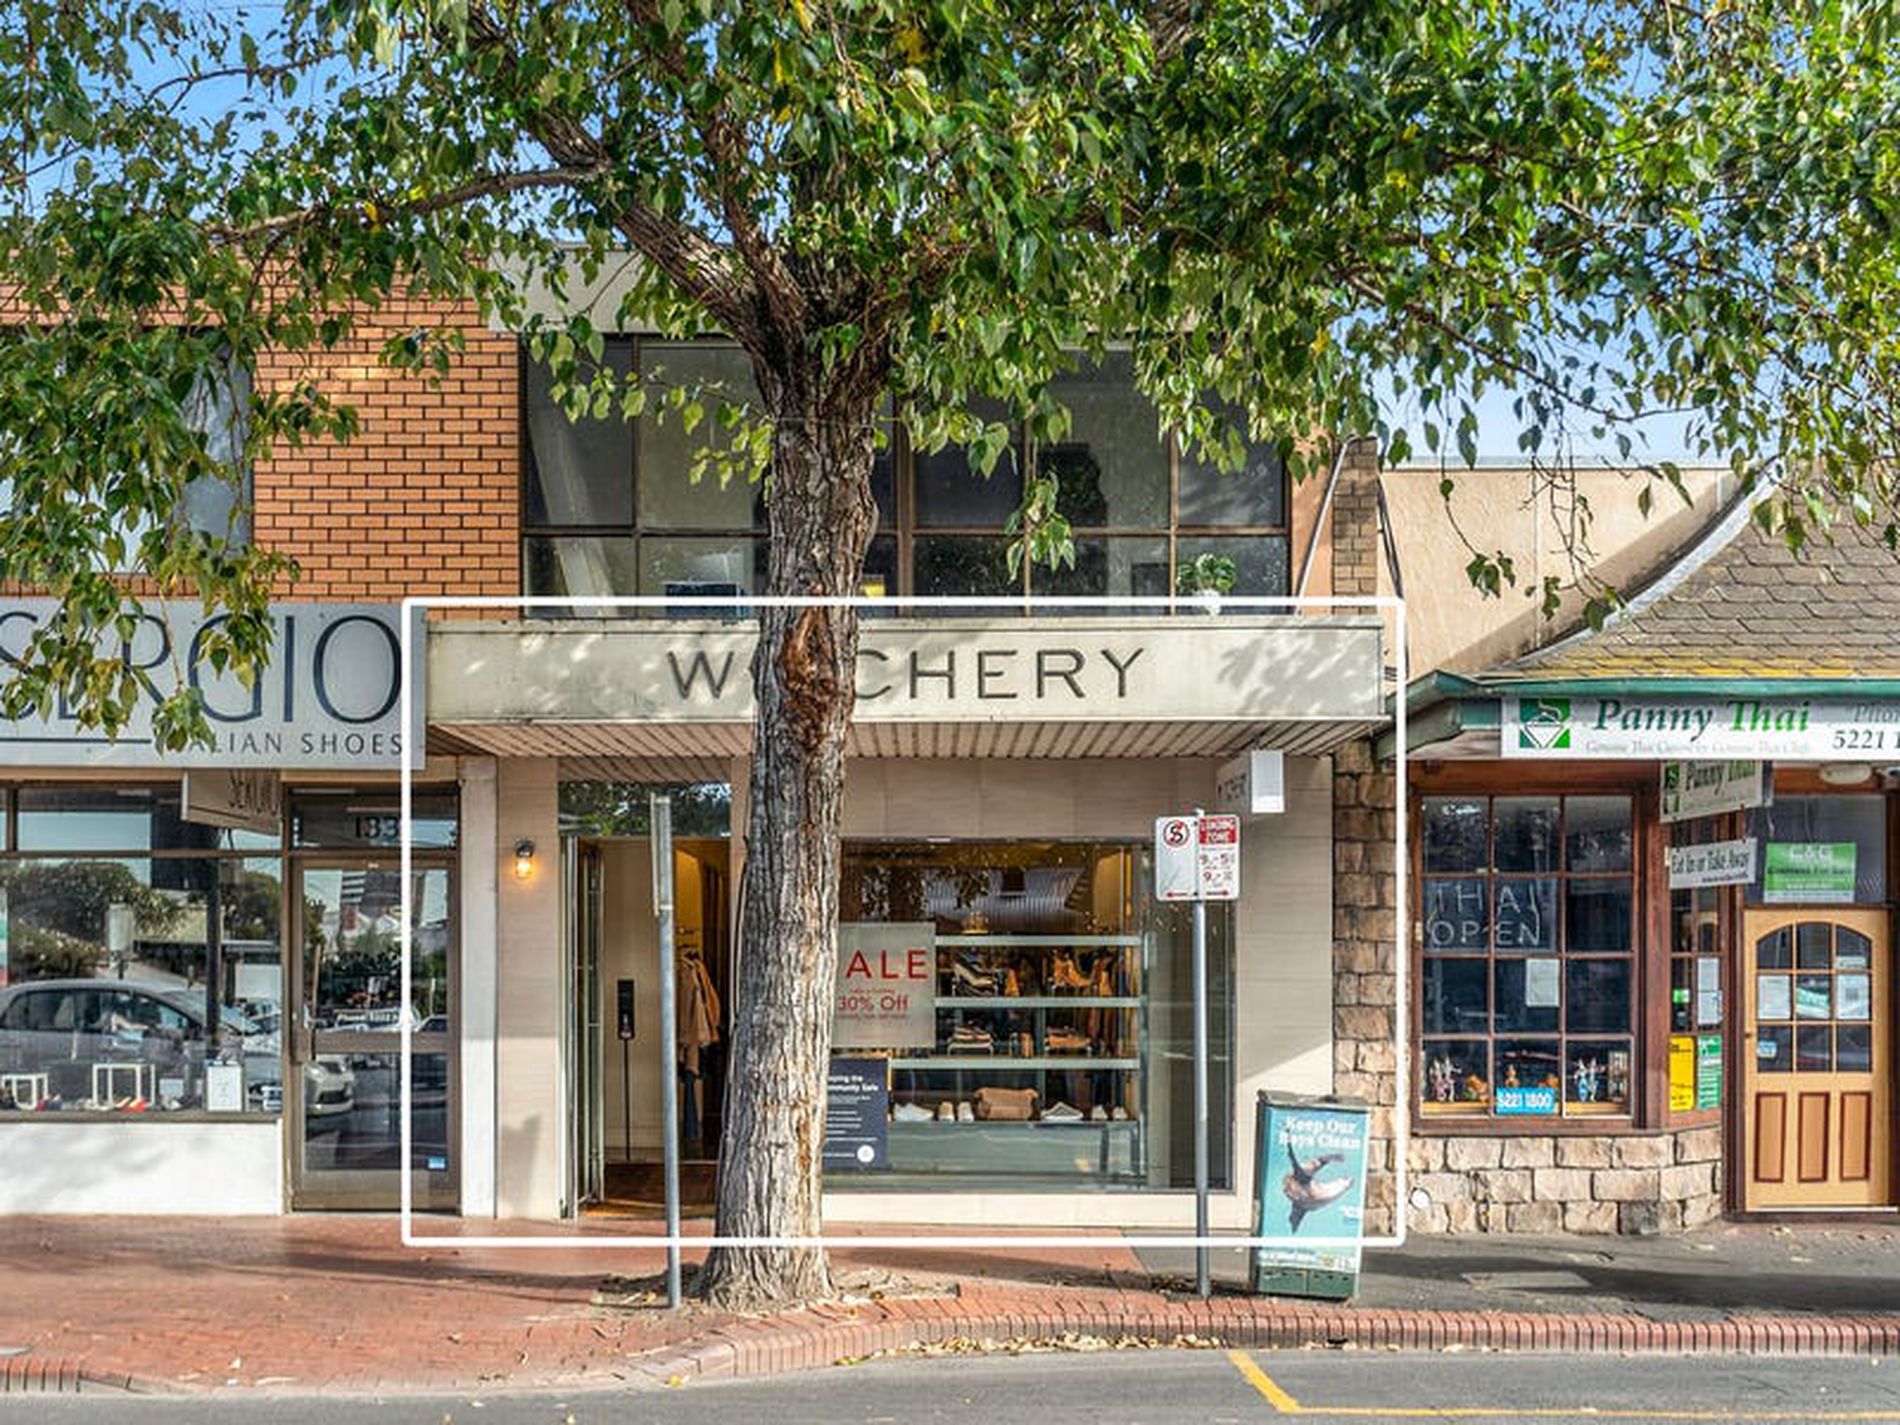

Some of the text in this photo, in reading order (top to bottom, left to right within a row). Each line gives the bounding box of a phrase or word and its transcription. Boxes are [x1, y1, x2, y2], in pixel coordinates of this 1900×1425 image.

[667, 647, 1145, 700] WCHERY
[1593, 699, 1809, 742] Panny Thai
[302, 733, 402, 755] SHOES
[1832, 729, 1886, 749] 5221
[1431, 920, 1540, 946] OPEN
[845, 950, 929, 980] ALE
[880, 993, 909, 1012] Off
